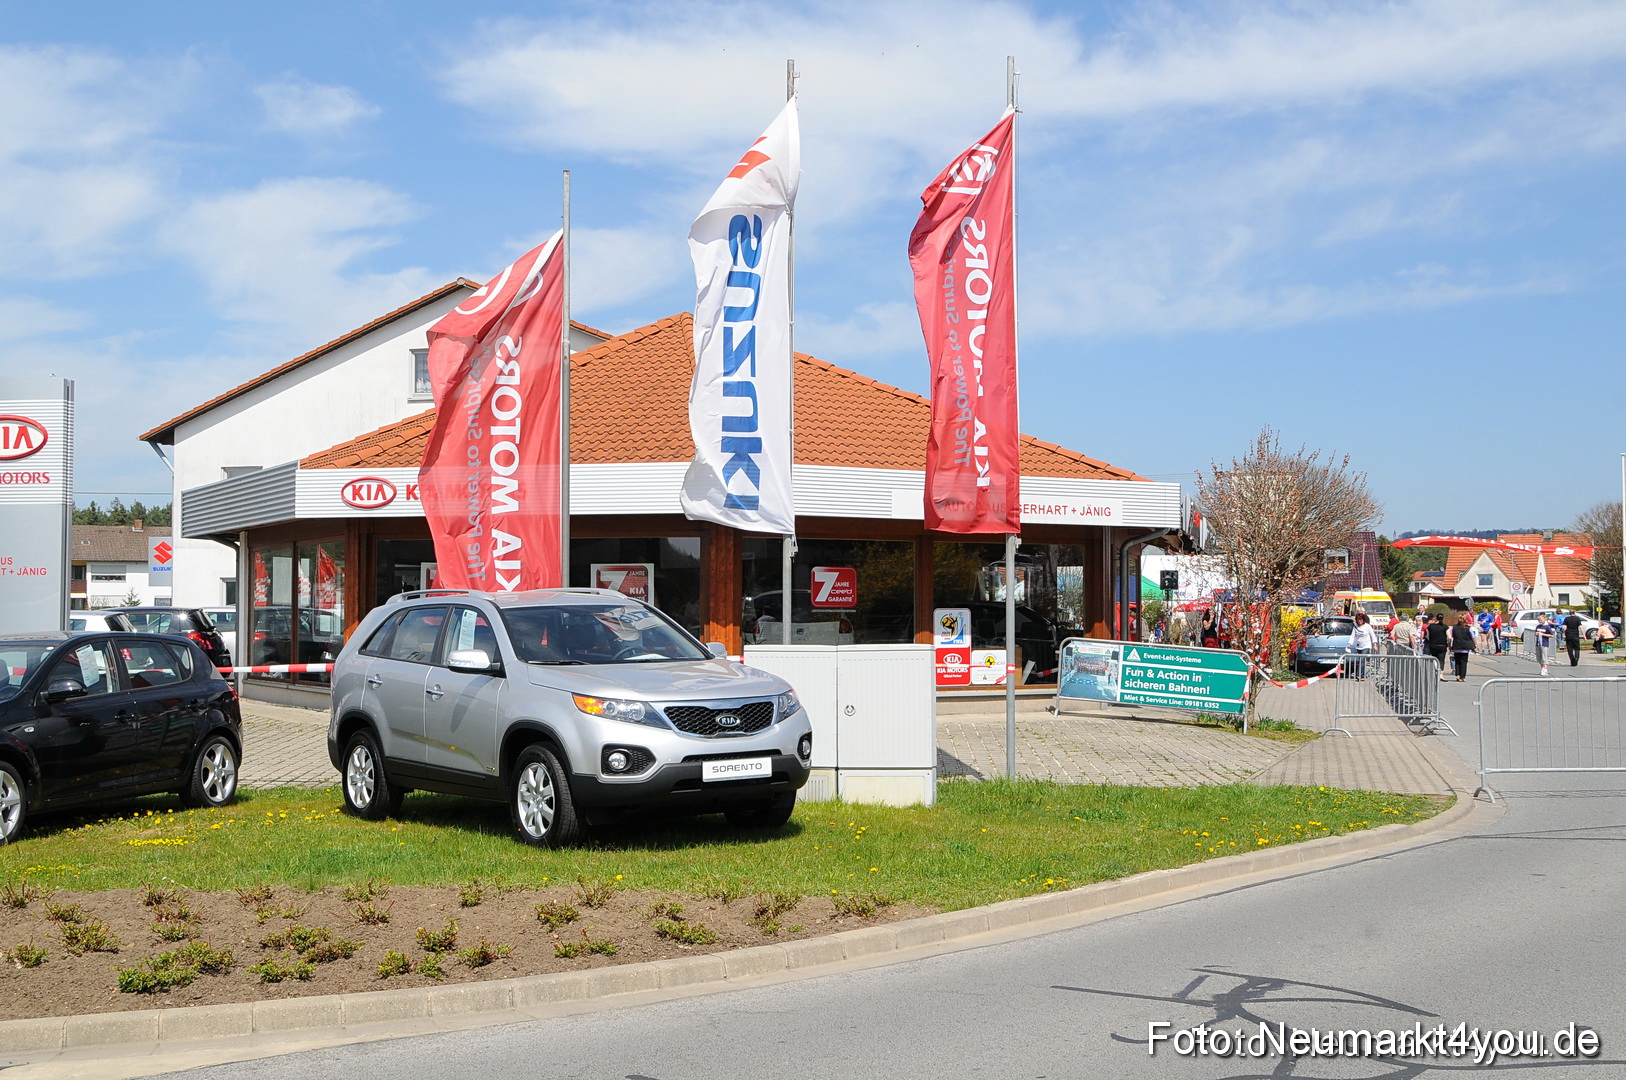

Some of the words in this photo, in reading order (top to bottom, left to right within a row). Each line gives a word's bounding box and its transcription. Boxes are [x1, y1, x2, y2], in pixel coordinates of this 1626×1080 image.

[0, 426, 34, 450] IA
[0, 471, 51, 485] OTORS
[352, 484, 388, 501] KIA
[1080, 504, 1112, 517] JÄNIG
[0, 556, 14, 566] US
[17, 565, 47, 576] JÄNIG
[629, 587, 646, 595] KIA
[814, 571, 840, 602] 7
[946, 655, 960, 664] KIA
[1143, 652, 1202, 664] Event-Leit-Systeme
[1125, 667, 1144, 678] Fun
[1146, 668, 1155, 679] &
[1156, 669, 1190, 682] Action
[1192, 672, 1202, 683] in
[1124, 678, 1166, 691] sicheren
[1168, 682, 1210, 695] Bahnen!
[1123, 694, 1138, 702] Miet
[720, 717, 736, 725] KIA
[712, 762, 763, 774] SORENTO
